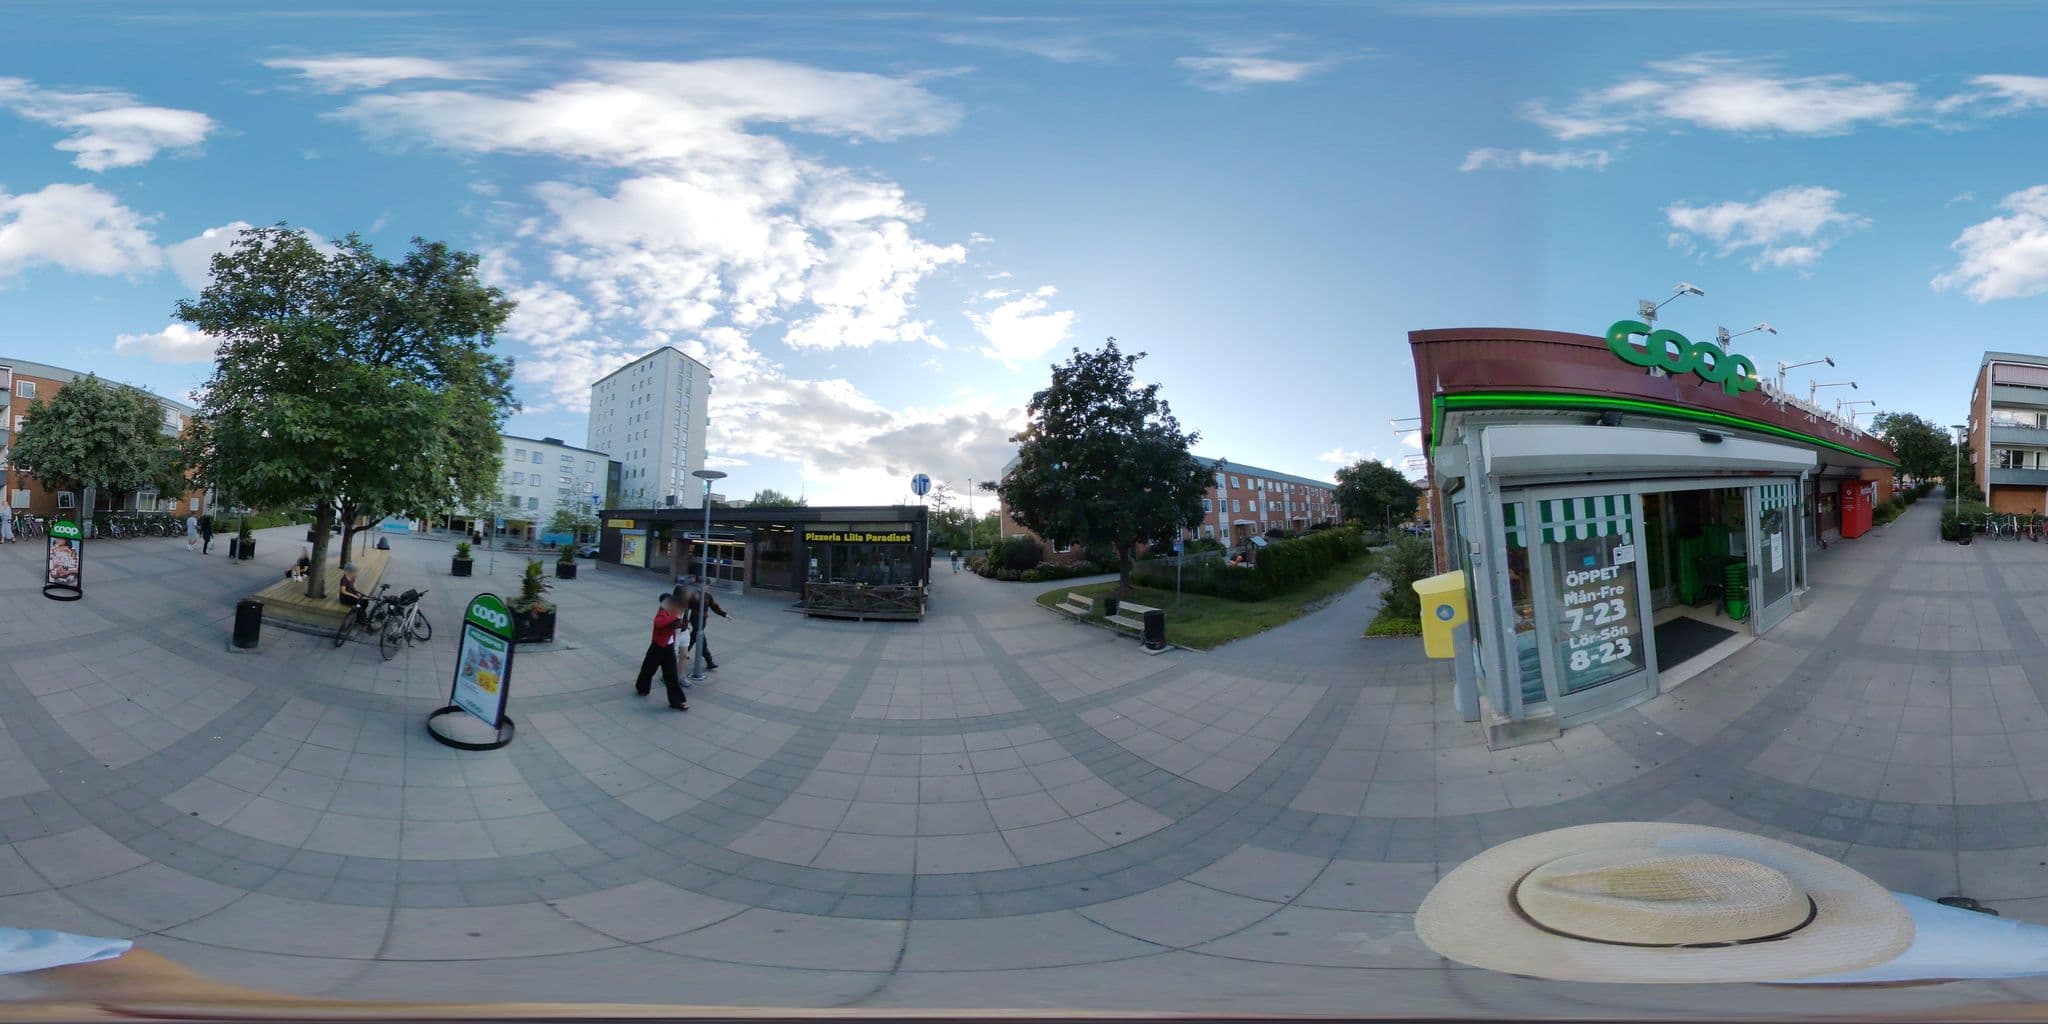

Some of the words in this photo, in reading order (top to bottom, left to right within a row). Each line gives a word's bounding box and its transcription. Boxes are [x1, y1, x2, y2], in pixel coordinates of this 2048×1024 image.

[1606, 320, 1758, 397] coop
[54, 525, 78, 536] coop
[805, 533, 841, 541] Pizzeria
[844, 533, 864, 542] Lilla
[866, 533, 912, 542] Paradiset
[1566, 565, 1620, 587] ÖPPET
[1564, 585, 1625, 607] Mån-Fre
[472, 603, 509, 629] coop
[1565, 598, 1627, 632] 7-23
[1569, 625, 1628, 649] Lör-Sön
[1570, 637, 1632, 671] 8-23
